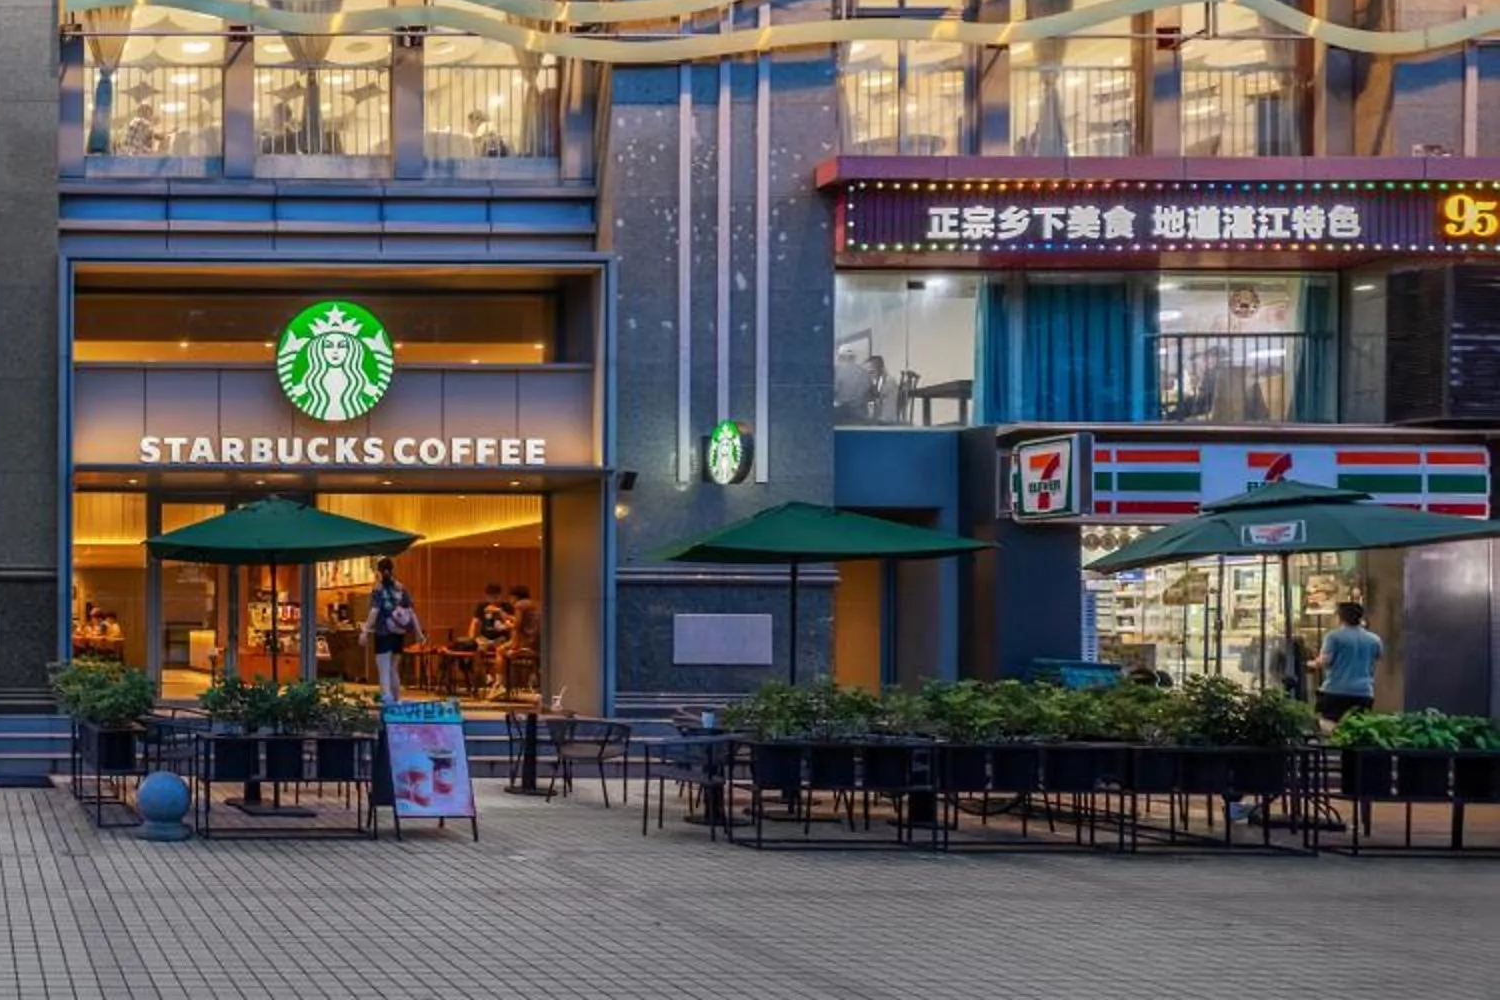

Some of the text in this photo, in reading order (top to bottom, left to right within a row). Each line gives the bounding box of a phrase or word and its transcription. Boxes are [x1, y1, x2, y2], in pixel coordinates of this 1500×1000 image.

[927, 205, 1136, 240] 正宗乡下美食
[1152, 205, 1363, 240] 地道湛江特色
[138, 436, 547, 465] STARBUCKS COFFEE
